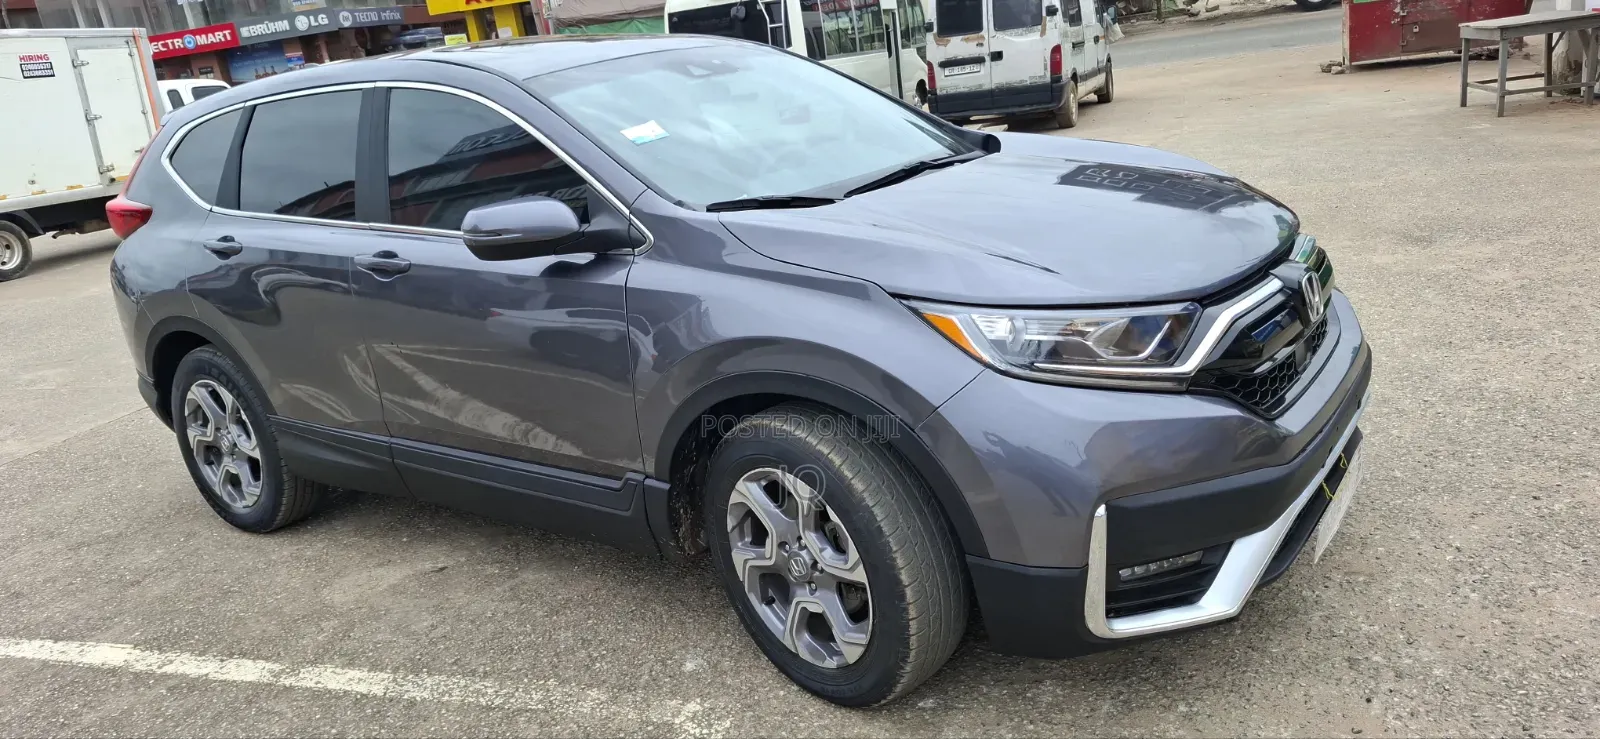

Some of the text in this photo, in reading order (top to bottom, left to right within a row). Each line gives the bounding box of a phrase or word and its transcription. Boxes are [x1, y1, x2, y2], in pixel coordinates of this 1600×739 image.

[309, 14, 329, 27] LG
[354, 12, 379, 22] TECNO
[380, 10, 402, 20] Infinix
[151, 31, 232, 54] ECTROMART
[19, 54, 50, 62] HIRING
